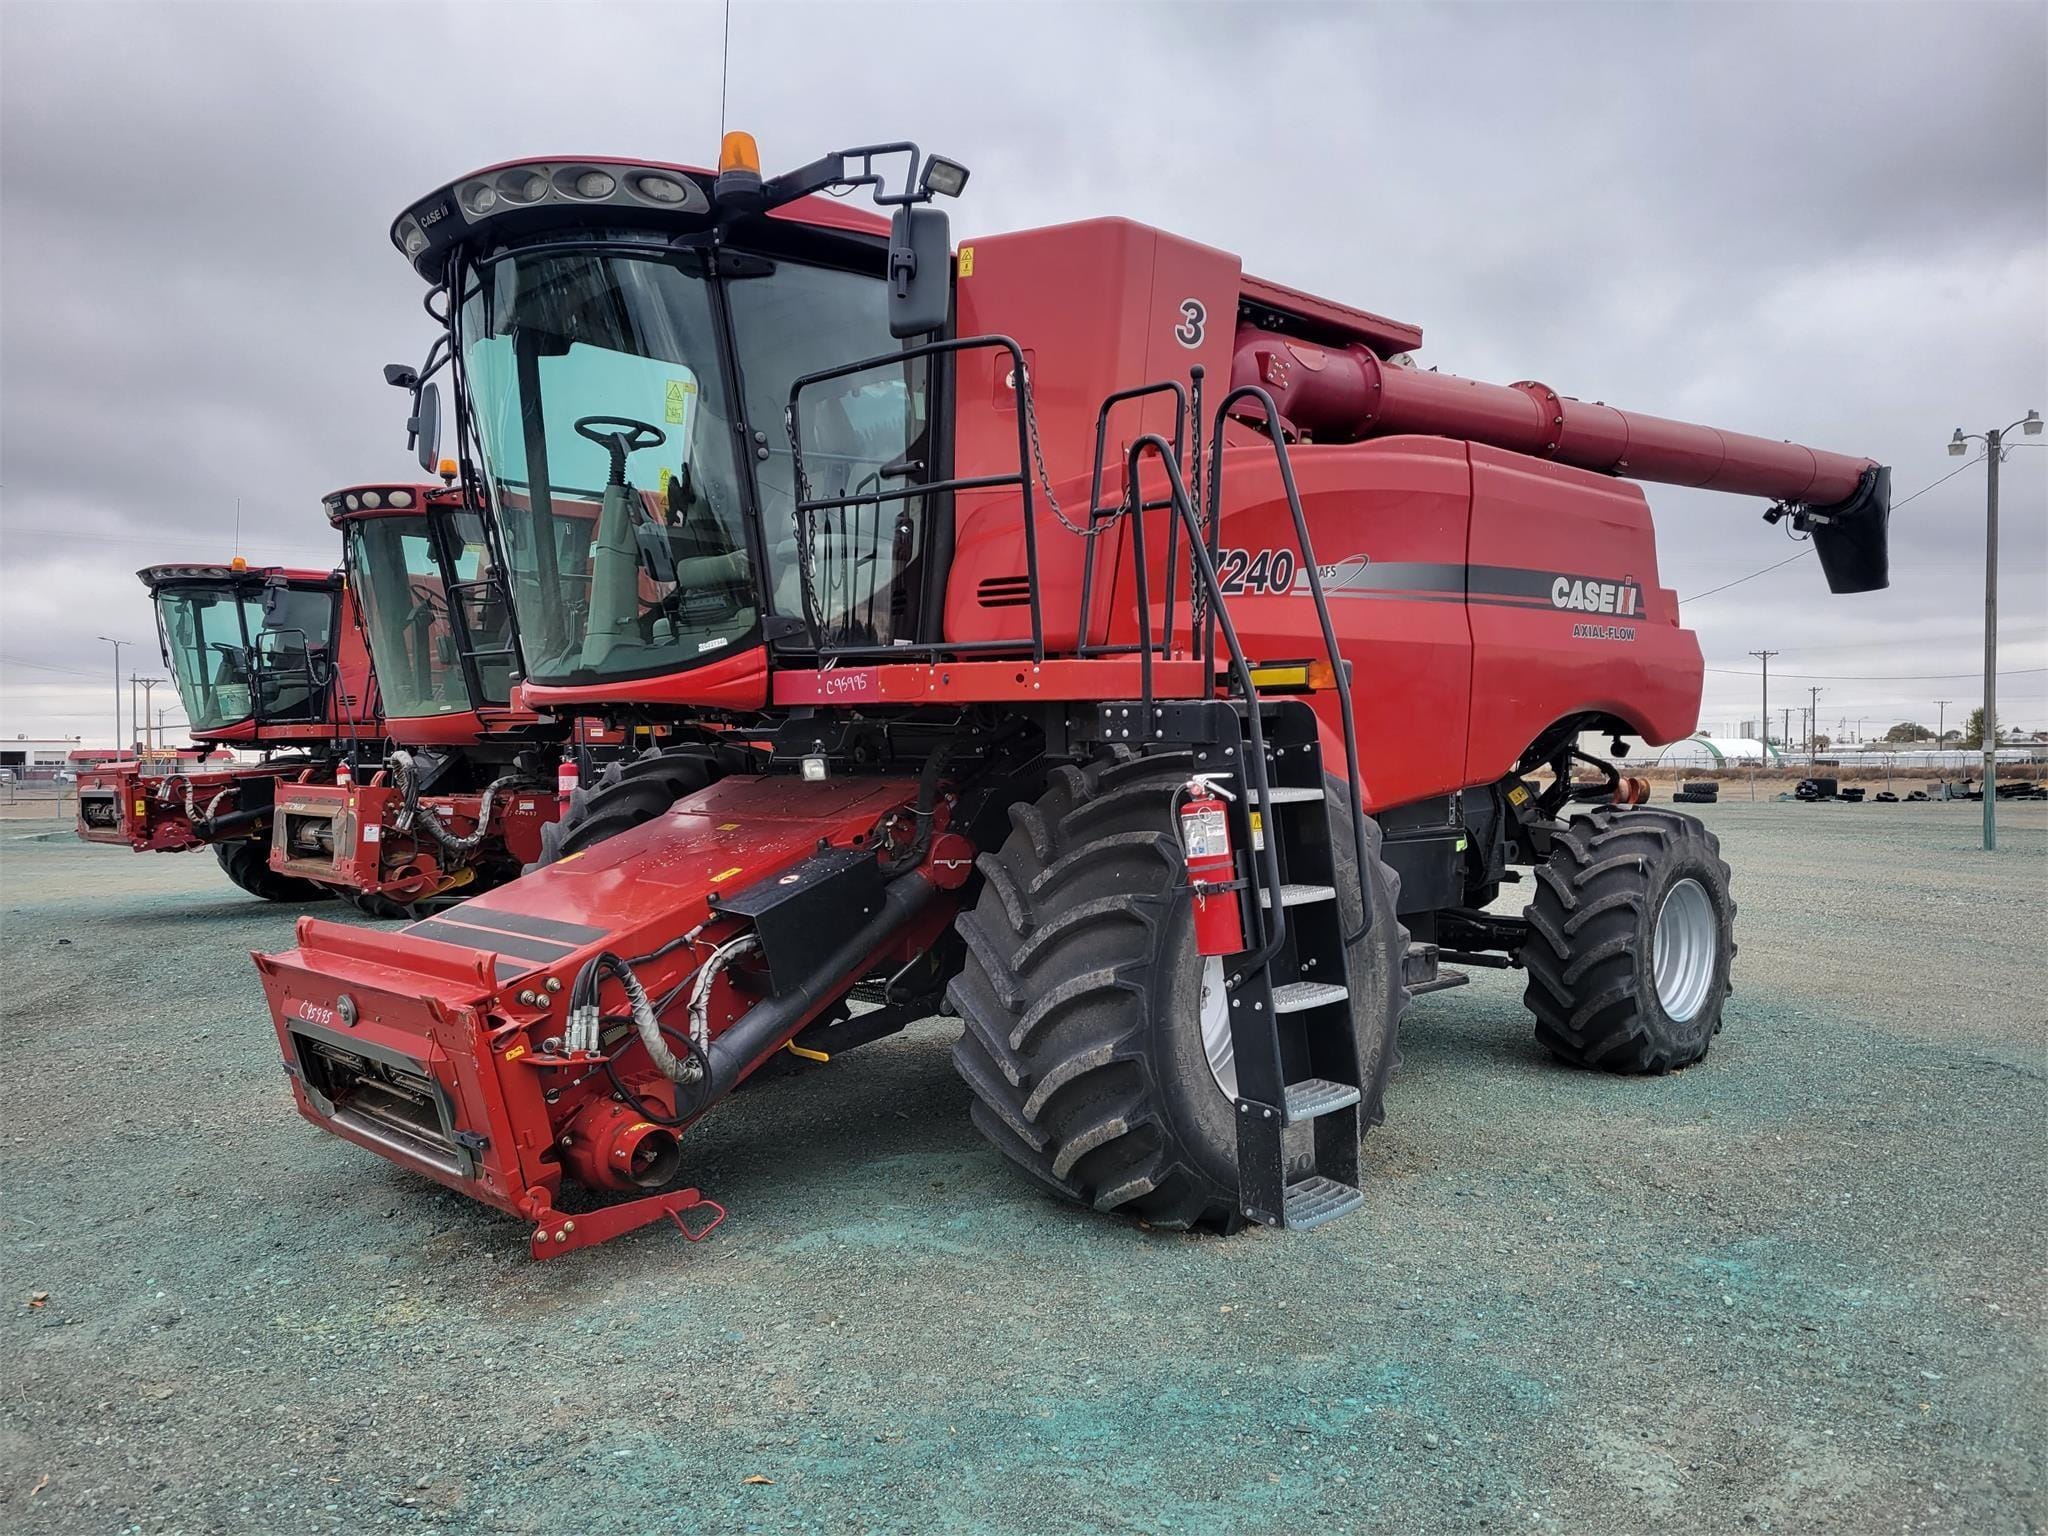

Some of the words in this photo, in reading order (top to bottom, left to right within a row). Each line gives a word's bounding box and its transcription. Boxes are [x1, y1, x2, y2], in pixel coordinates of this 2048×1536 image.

[420, 209, 441, 228] CASE
[1174, 297, 1207, 349] 3
[1318, 565, 1337, 578] AFS
[1551, 576, 1616, 613] CASE
[1573, 623, 1636, 642] AXIAL-FLOW
[826, 672, 868, 695] C95995
[299, 1000, 333, 1024] C95995
